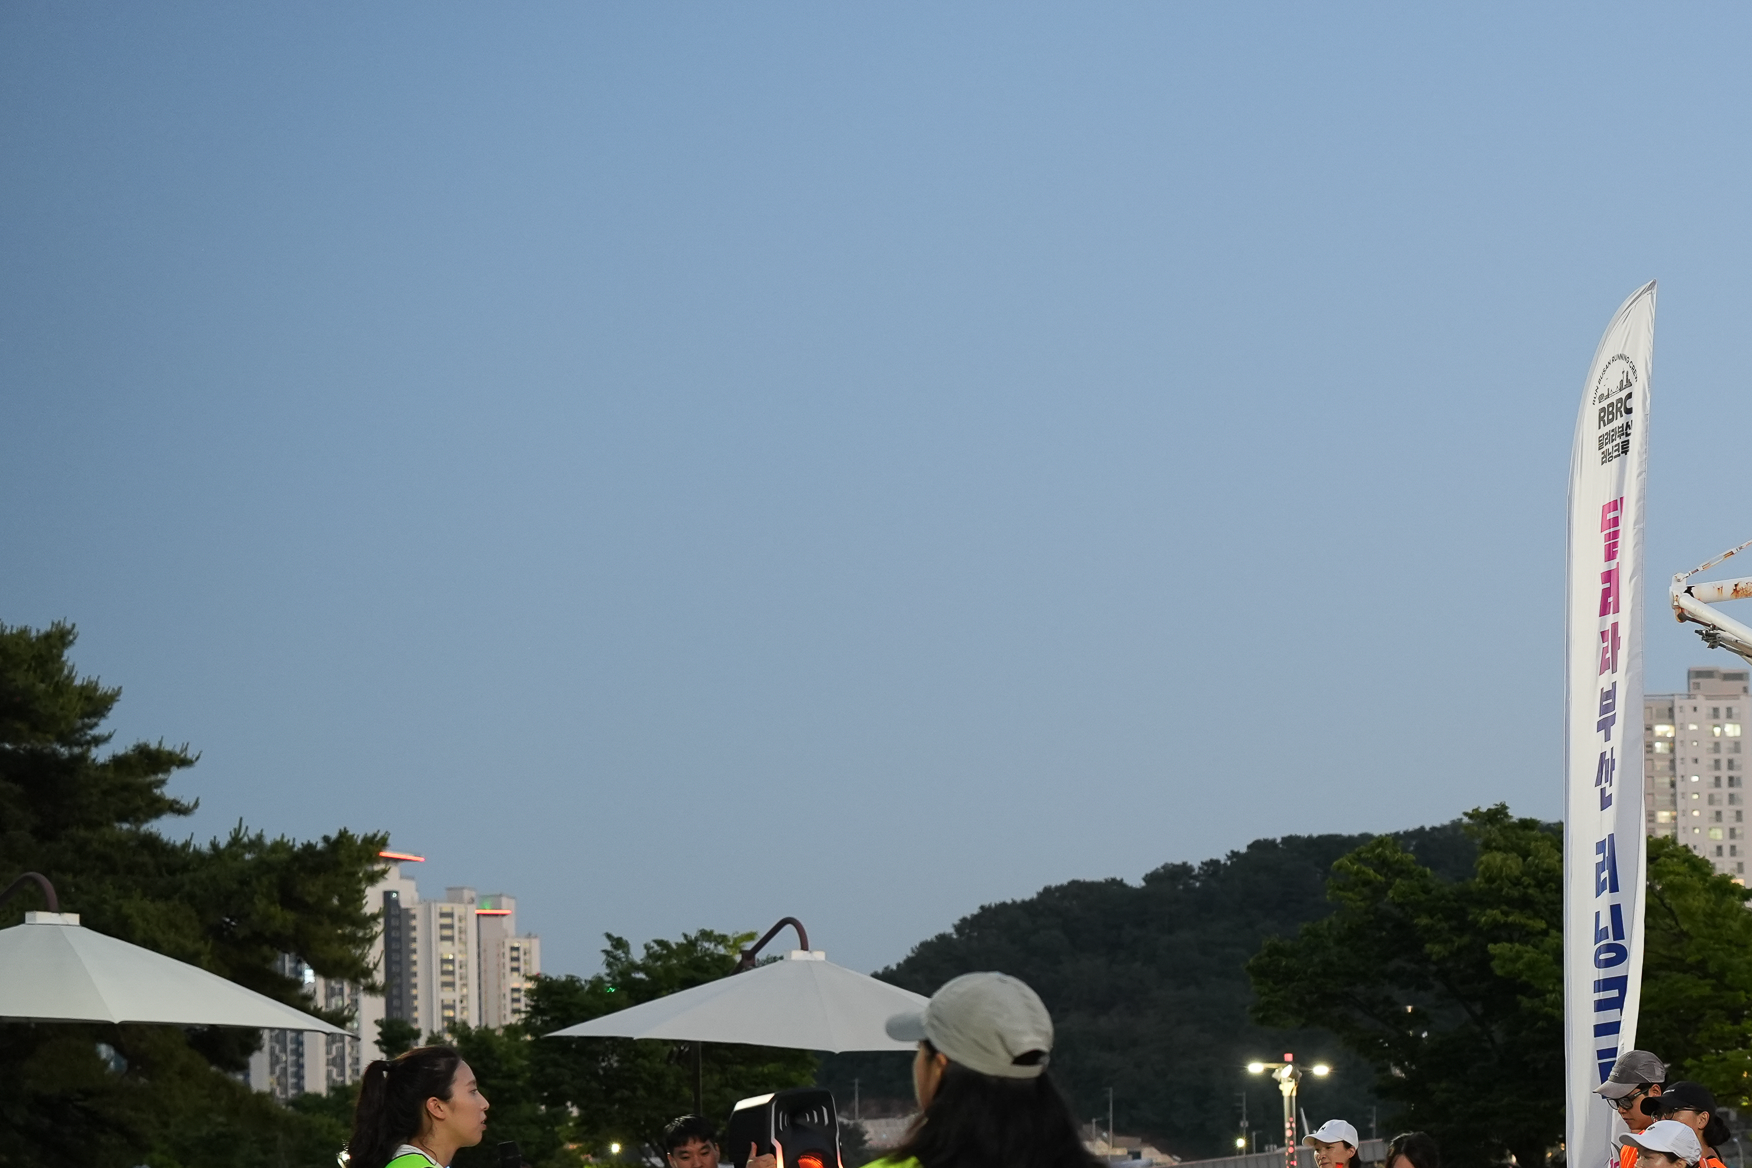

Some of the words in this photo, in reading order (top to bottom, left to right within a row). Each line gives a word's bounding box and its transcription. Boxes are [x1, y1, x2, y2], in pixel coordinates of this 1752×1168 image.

[1598, 392, 1633, 430] RBRC
[1598, 420, 1632, 451] 달려라부산
[1600, 439, 1630, 466] 러닝크루
